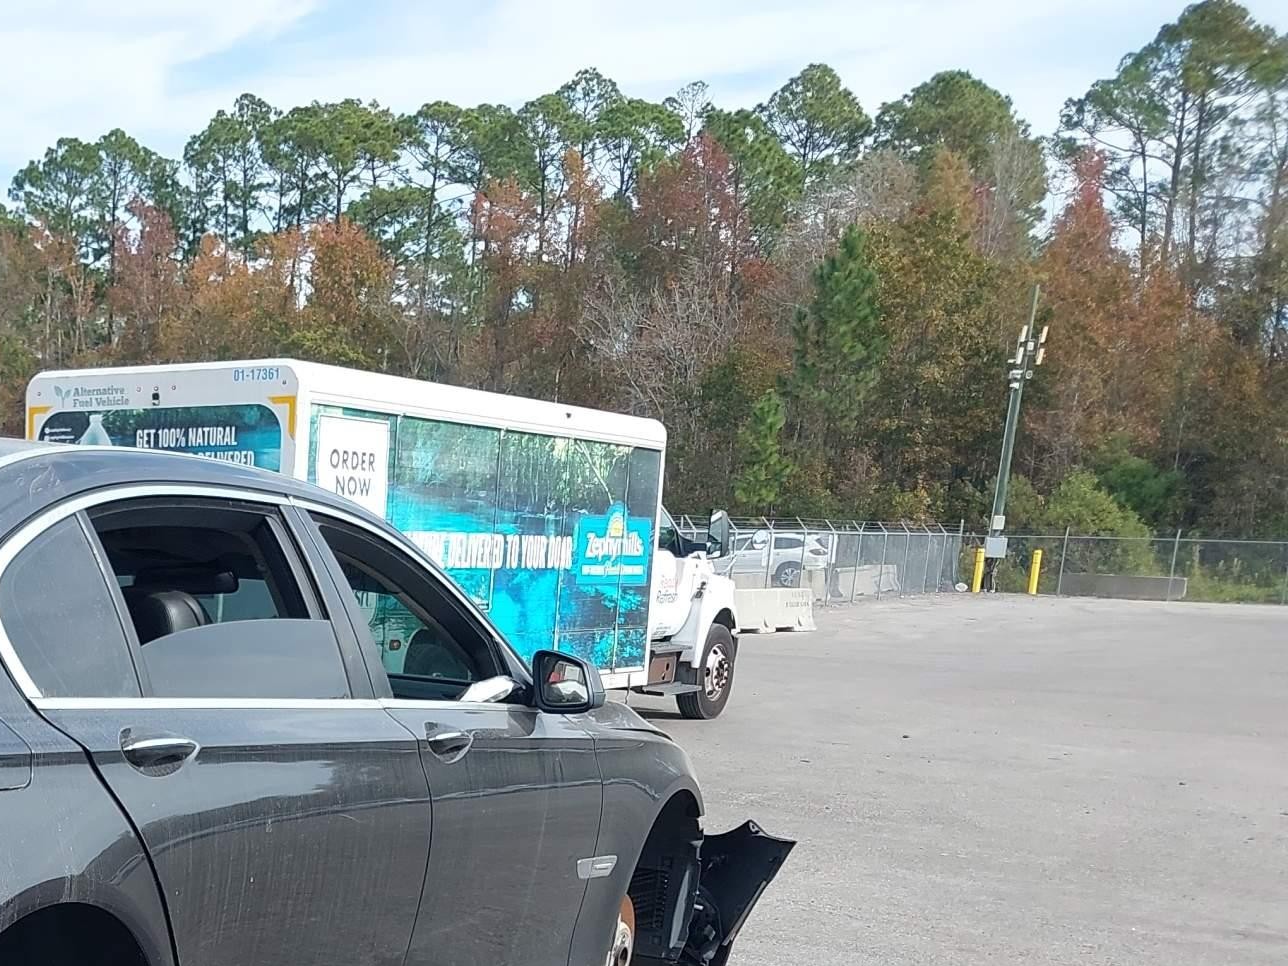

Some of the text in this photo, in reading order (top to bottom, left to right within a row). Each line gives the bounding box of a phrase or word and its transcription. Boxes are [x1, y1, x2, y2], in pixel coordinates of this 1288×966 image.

[233, 367, 280, 382] 01-17361
[72, 385, 125, 397] Alternative
[72, 396, 130, 408] Fuel Vehicle
[136, 426, 238, 448] GET 100% NATURAL
[329, 448, 376, 473] ORDER
[335, 475, 372, 497] NOW
[506, 535, 520, 569] TO
[521, 535, 548, 569] YOUR
